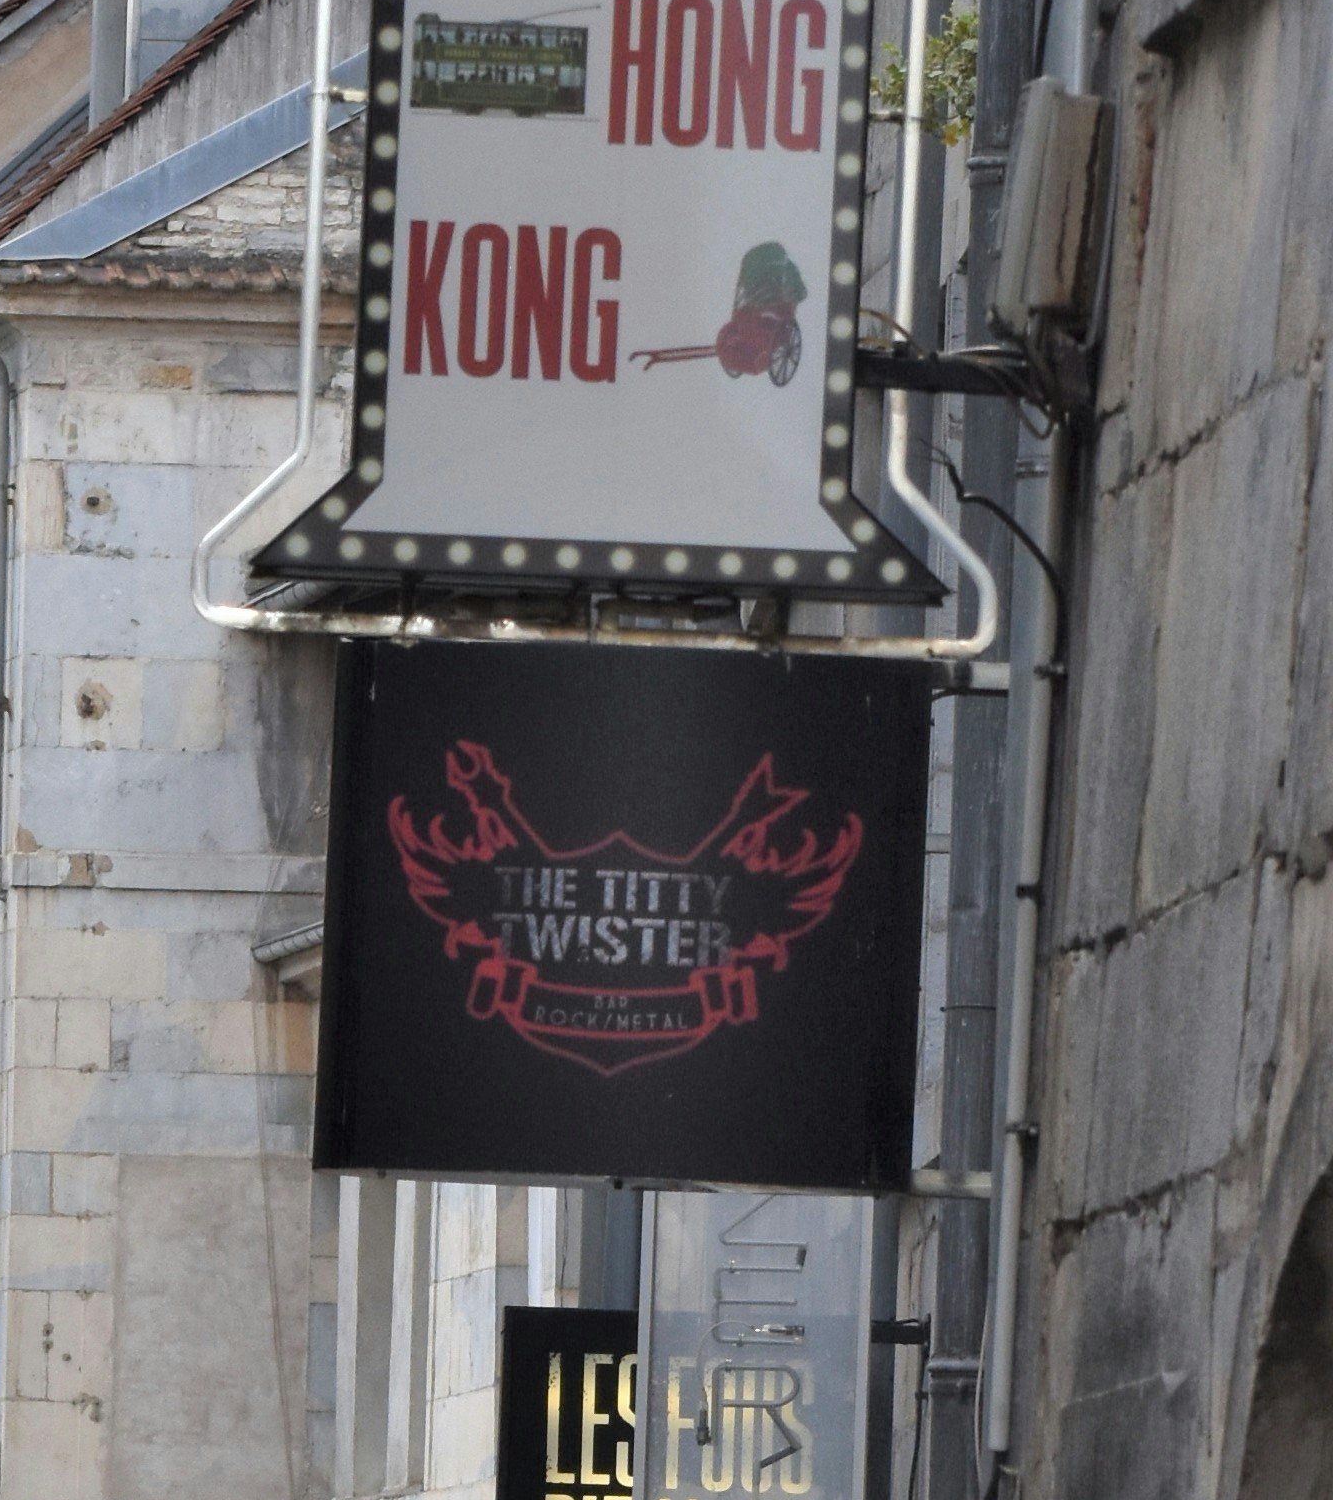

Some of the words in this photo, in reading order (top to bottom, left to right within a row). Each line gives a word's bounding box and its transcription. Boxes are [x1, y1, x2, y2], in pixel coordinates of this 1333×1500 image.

[404, 218, 623, 385] KONG
[494, 867, 578, 909] THE
[596, 870, 732, 915] TITTY
